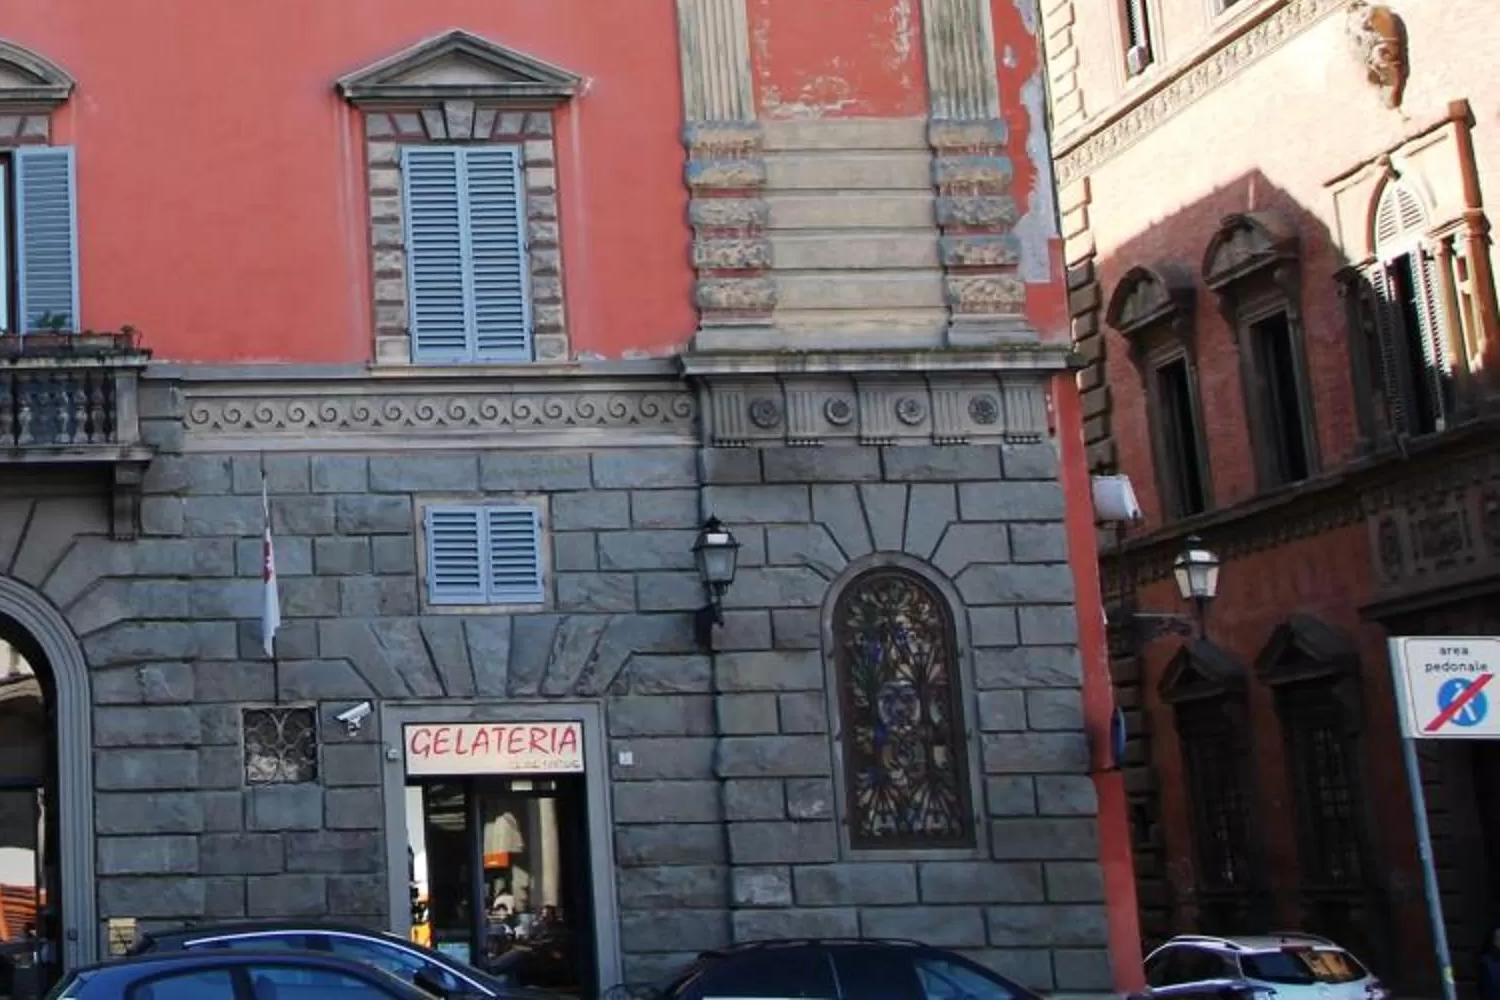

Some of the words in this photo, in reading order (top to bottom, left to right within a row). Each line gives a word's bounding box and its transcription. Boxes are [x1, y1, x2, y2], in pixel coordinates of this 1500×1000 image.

[1440, 647, 1469, 656] area
[1425, 660, 1488, 673] pedonale
[411, 726, 577, 758] GELATERIA
